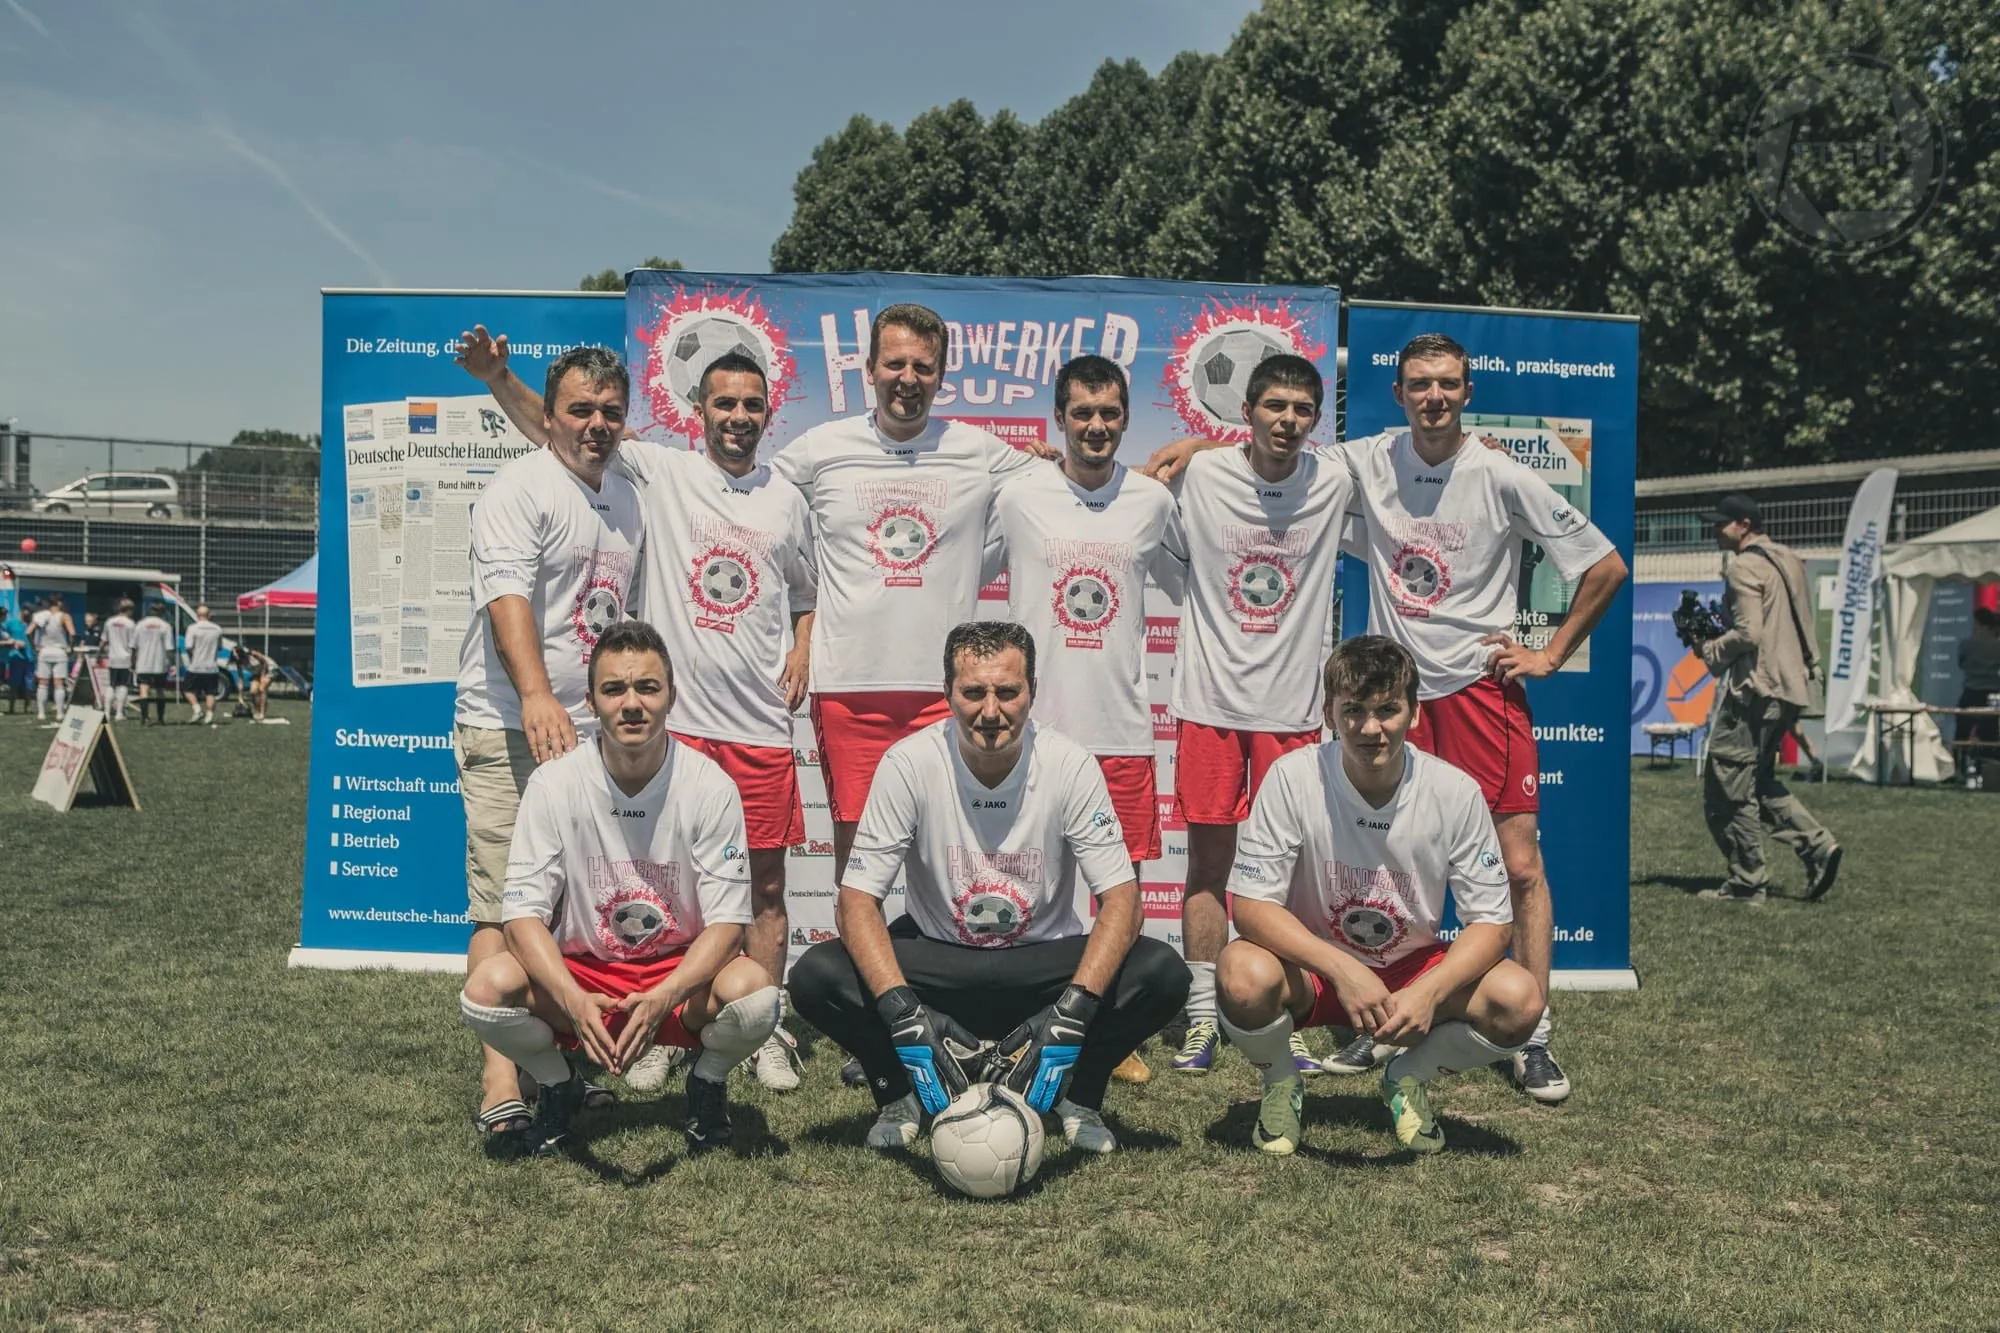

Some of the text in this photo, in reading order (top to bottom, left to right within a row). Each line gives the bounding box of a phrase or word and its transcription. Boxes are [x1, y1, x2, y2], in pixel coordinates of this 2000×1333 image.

[346, 338, 372, 353] Die
[377, 338, 439, 358] Zeitung,
[820, 308, 1140, 413] HDWERKER
[1516, 360, 1616, 379] praxisgerecht
[348, 445, 405, 466] Deutsche
[407, 441, 466, 459] Deutsche
[438, 480, 458, 489] Bund
[460, 481, 476, 490] hilft
[1423, 476, 1443, 484] JAKO
[731, 487, 750, 496] JAKO
[1263, 490, 1282, 498] JAKO
[1856, 520, 1878, 613] magazin
[1833, 536, 1867, 681] handwerk
[345, 775, 461, 794] Wirtschaft und
[343, 804, 411, 823] Regional
[621, 809, 646, 818] JAKO
[983, 801, 1007, 809] JAKO
[1368, 822, 1390, 831] JAKO
[343, 832, 400, 849] Betrieb
[342, 861, 398, 878] Service
[328, 907, 477, 925] www.deutsche-hand
